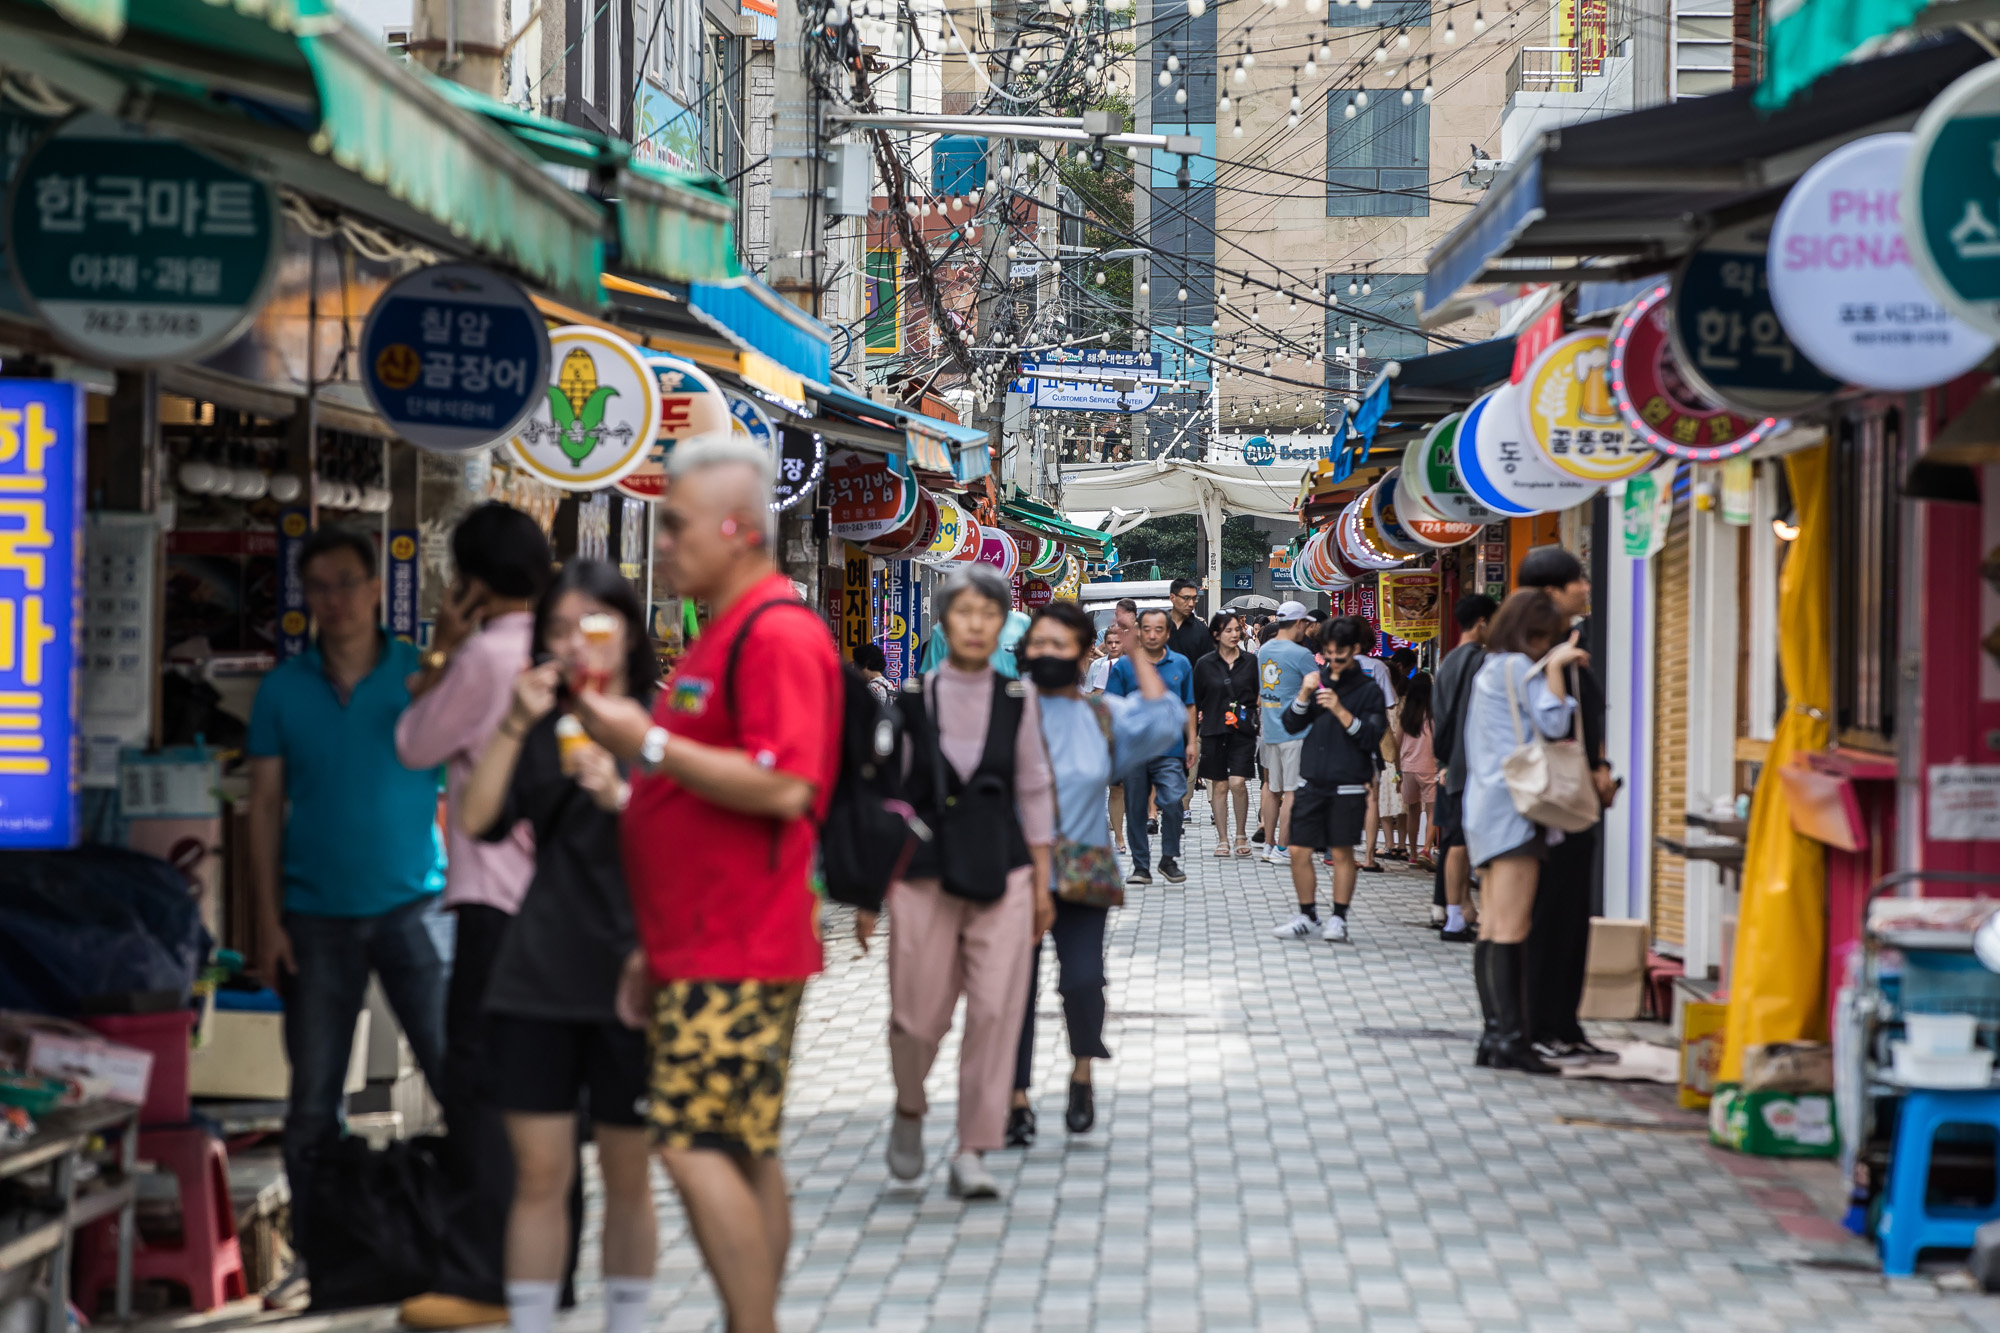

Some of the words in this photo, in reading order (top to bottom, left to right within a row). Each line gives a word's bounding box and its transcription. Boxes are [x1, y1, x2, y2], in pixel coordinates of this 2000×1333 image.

[35, 173, 257, 238] 한국마트
[423, 351, 528, 396] 곰장어
[1052, 393, 1088, 403] CUSTOMER
[1089, 395, 1116, 404] SERVICE
[1280, 445, 1317, 460] Best
[837, 521, 882, 533] 051-243-1855
[846, 558, 868, 648] 혜자네
